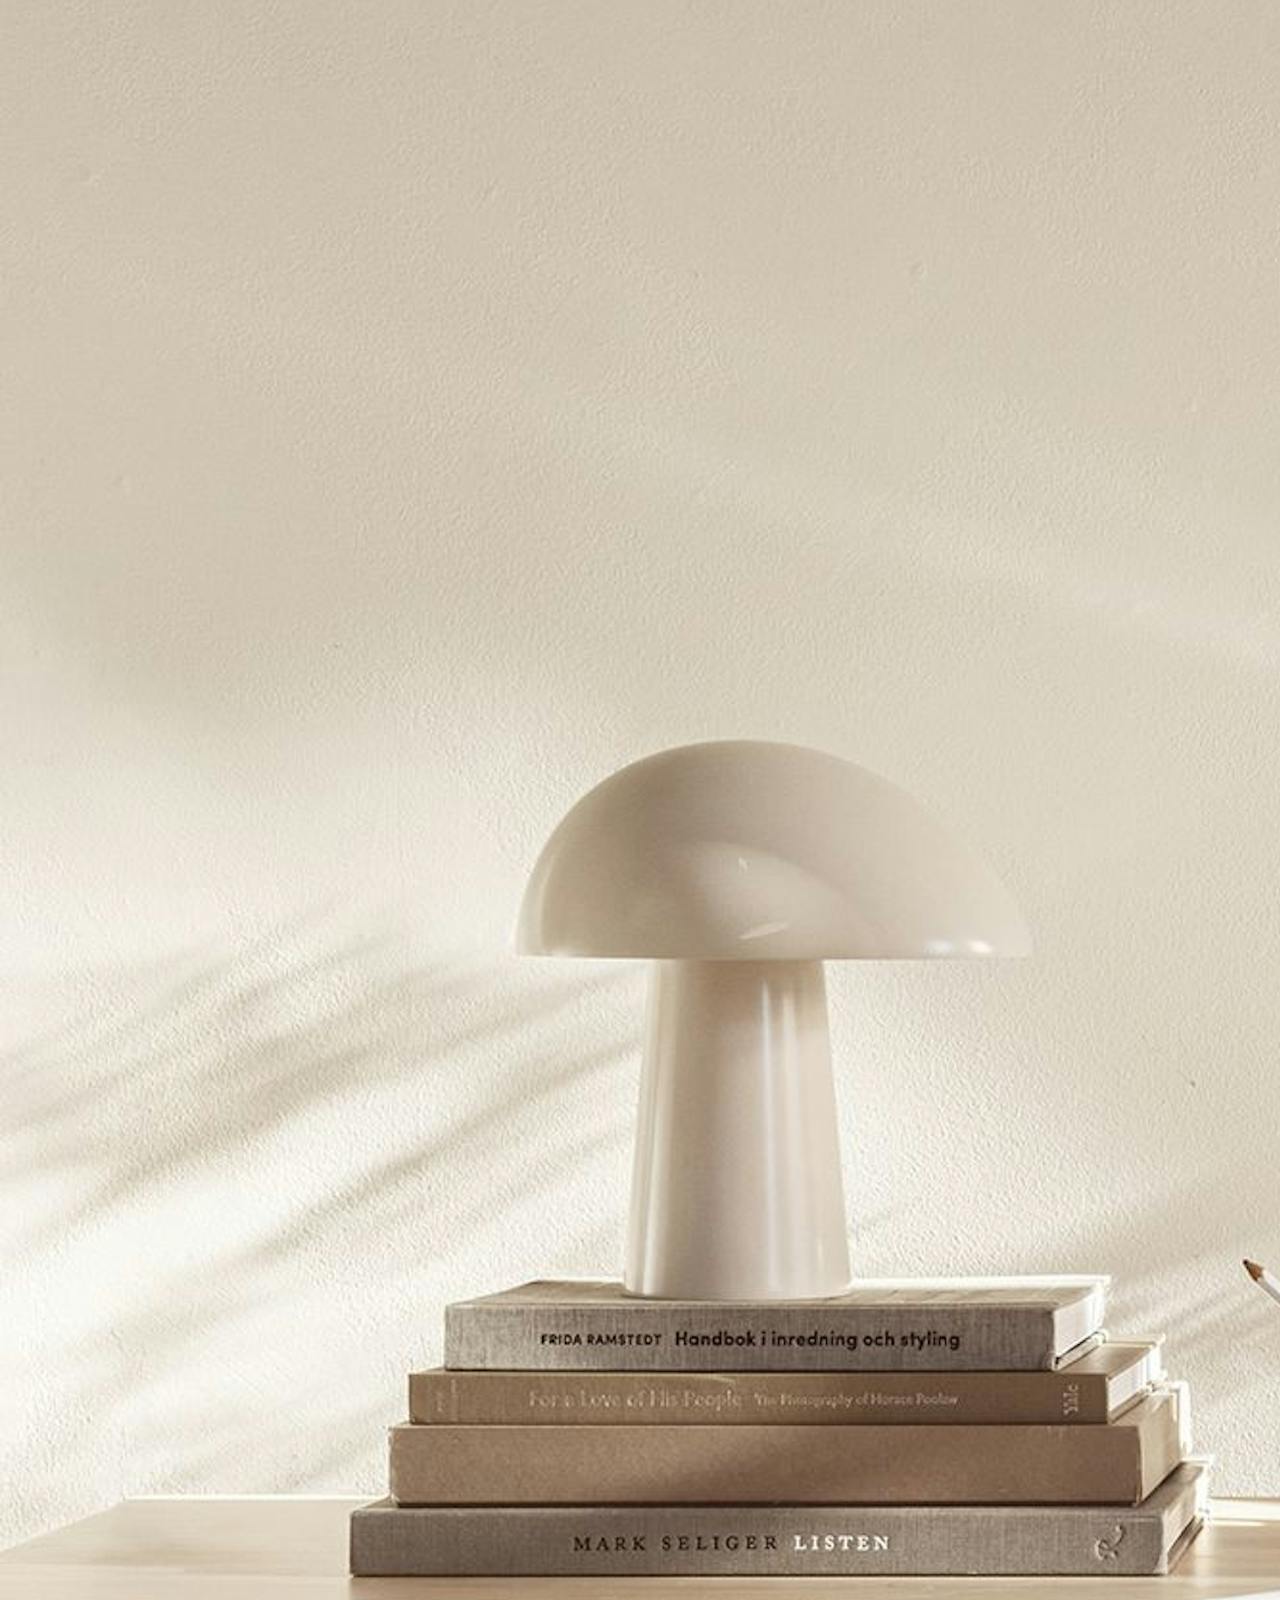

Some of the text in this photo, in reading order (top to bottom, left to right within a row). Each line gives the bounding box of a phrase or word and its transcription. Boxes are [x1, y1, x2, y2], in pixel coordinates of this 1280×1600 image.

[540, 1333, 663, 1346] FRIDA RAMSTEDT
[674, 1330, 962, 1352] Handbok i inredning och styling
[573, 1534, 778, 1552] MARK SELIGER
[793, 1534, 890, 1552] LISTEN
